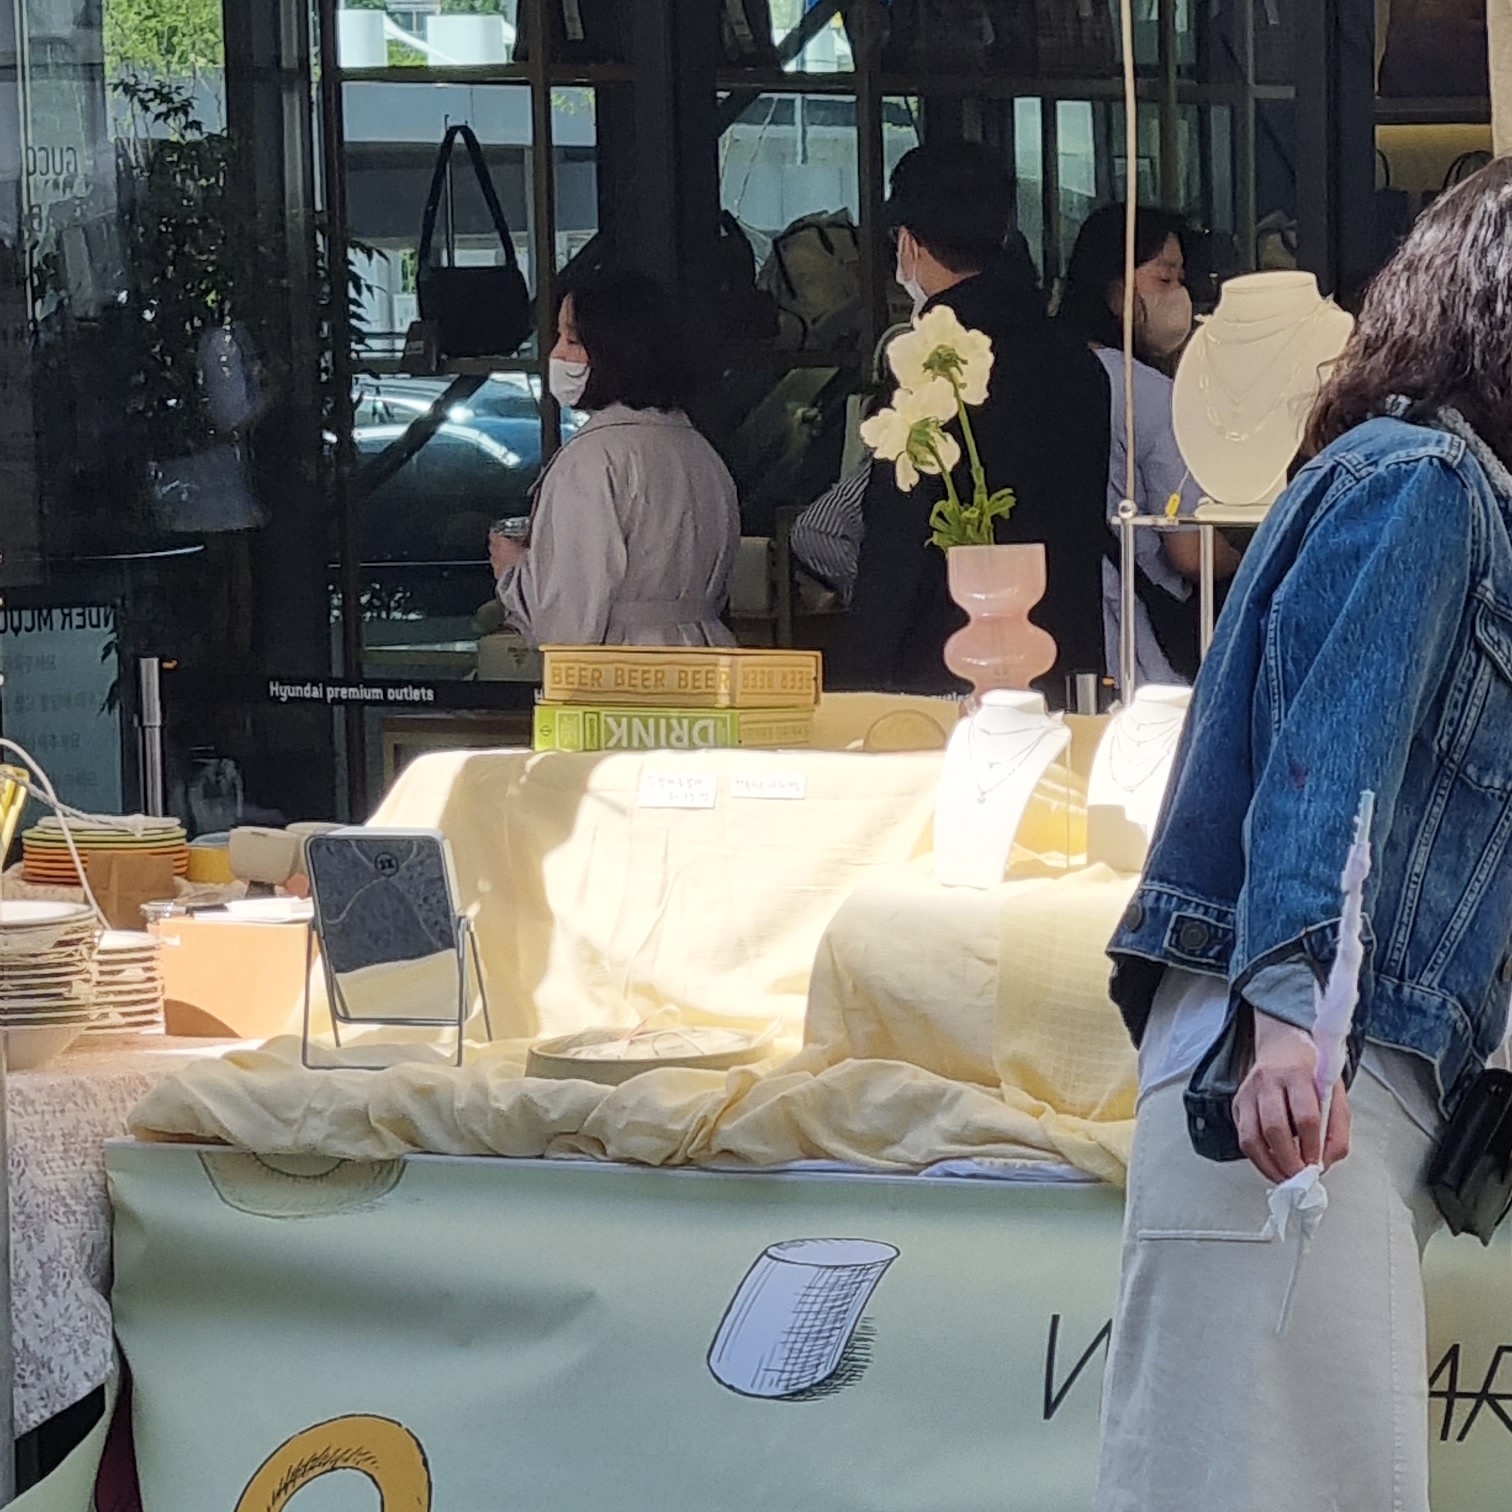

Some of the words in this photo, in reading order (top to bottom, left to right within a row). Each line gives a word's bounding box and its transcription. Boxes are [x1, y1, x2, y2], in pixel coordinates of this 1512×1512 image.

[551, 665, 603, 687] BEER
[614, 666, 666, 688] BEER
[677, 668, 730, 690] BEER
[269, 681, 323, 702] Hyundai
[327, 684, 384, 703] premium
[387, 685, 435, 701] outlets
[605, 716, 716, 749] DRINK
